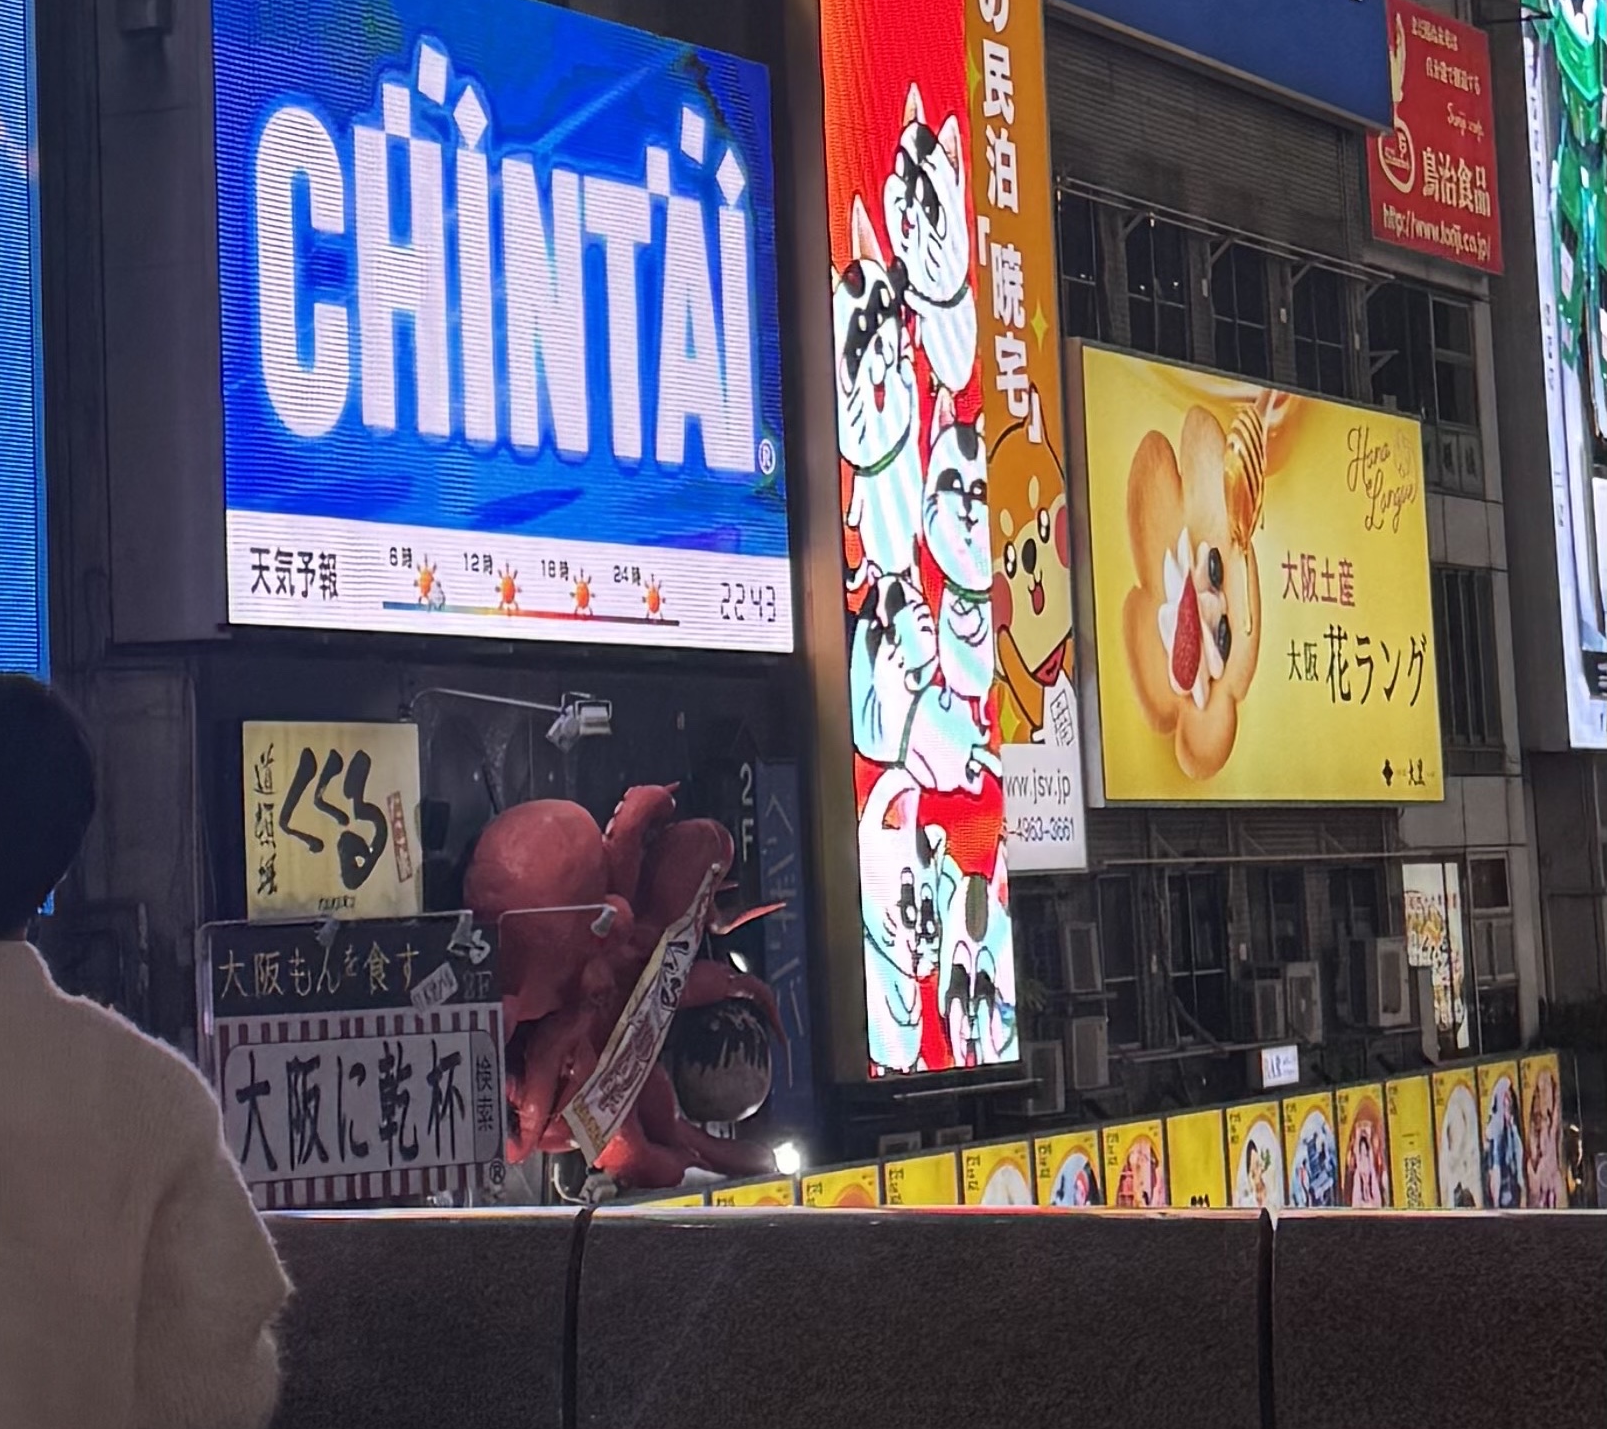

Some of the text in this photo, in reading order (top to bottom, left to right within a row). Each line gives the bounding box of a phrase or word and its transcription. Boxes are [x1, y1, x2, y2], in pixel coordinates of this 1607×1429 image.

[250, 546, 340, 601] 天気予報
[1281, 550, 1356, 608] 大阪土産
[236, 1039, 466, 1172] 大阪に乾杯
